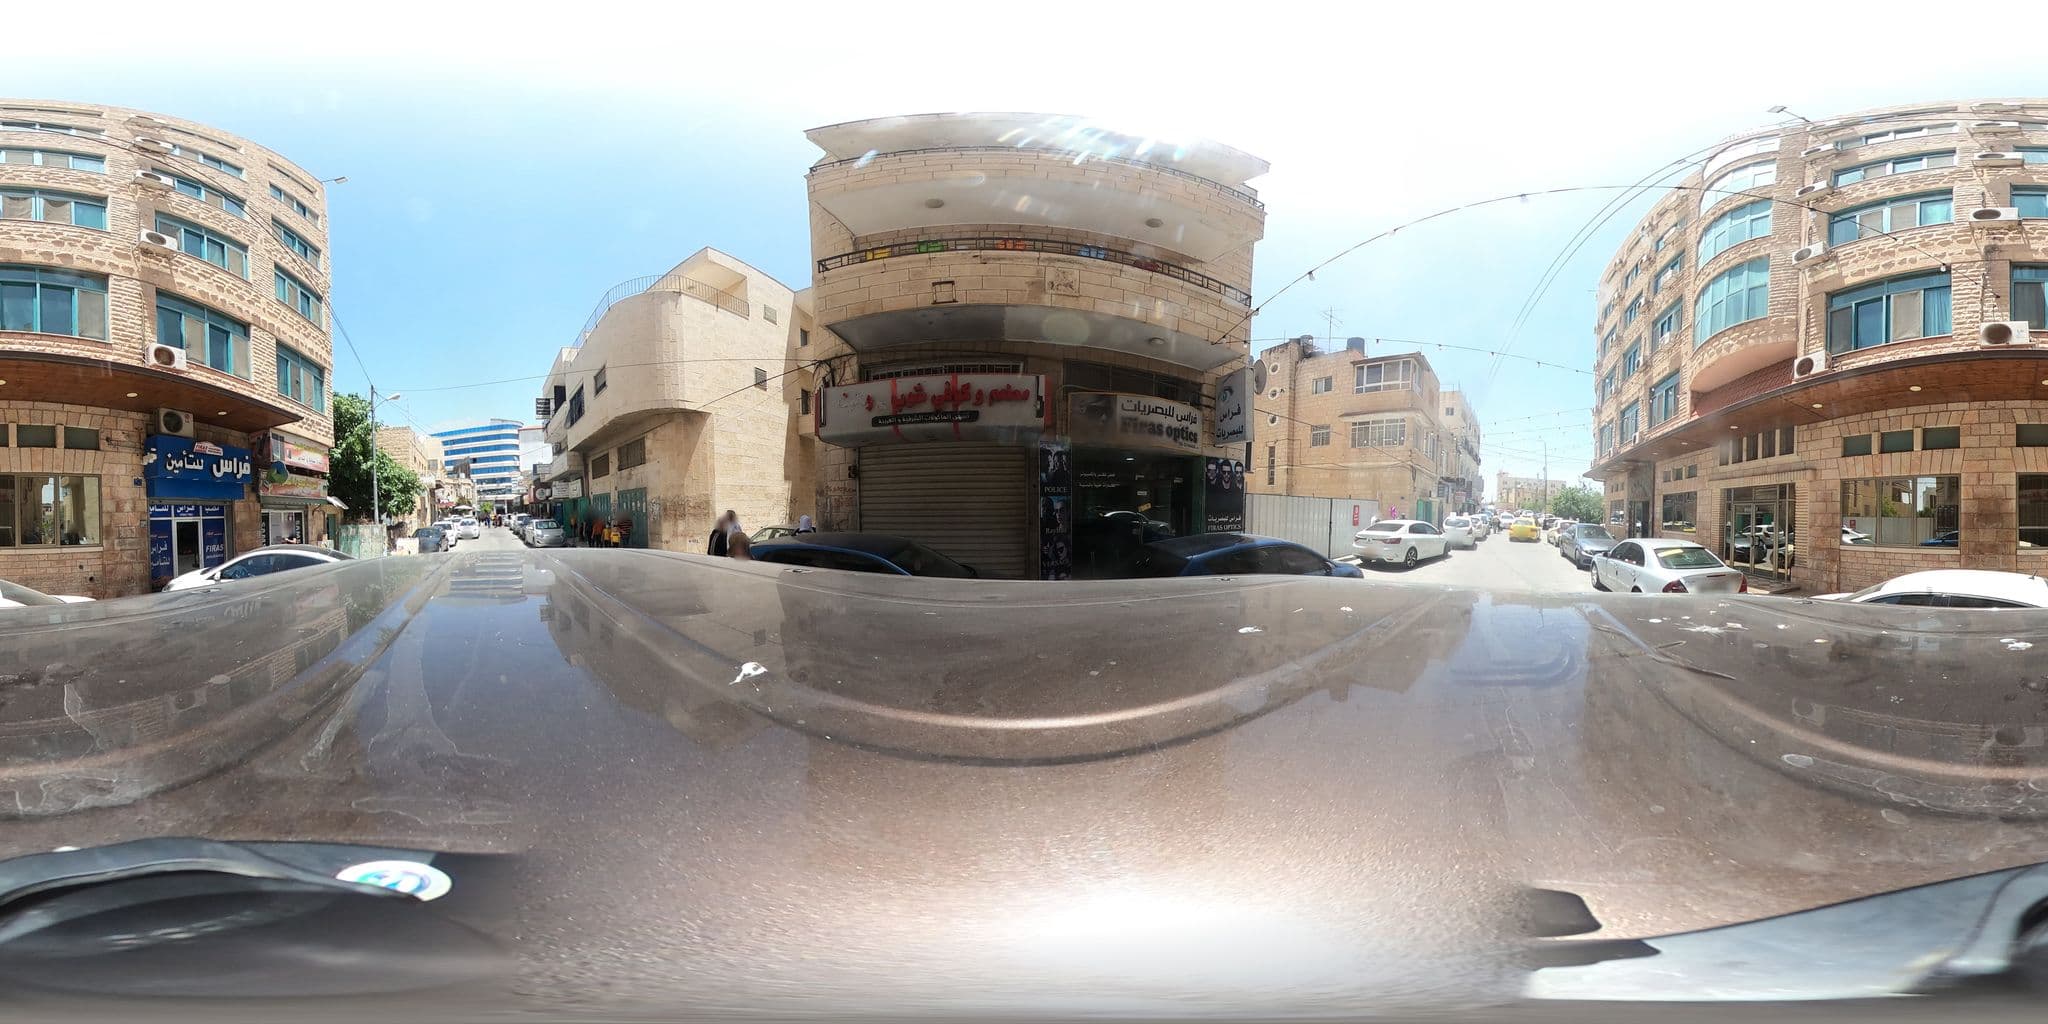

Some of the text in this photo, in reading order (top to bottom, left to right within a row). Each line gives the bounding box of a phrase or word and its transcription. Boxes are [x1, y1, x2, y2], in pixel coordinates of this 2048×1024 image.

[1121, 399, 1198, 425] فراس للبصريات
[1220, 403, 1242, 423] فراس
[1166, 424, 1198, 444] optics
[1216, 424, 1244, 440] للبصريات
[166, 450, 204, 474] للتأمين
[212, 455, 251, 479] فراس
[1044, 486, 1067, 494] POLICE
[1207, 524, 1223, 532] FIRAS
[205, 543, 224, 553] FIRAS
